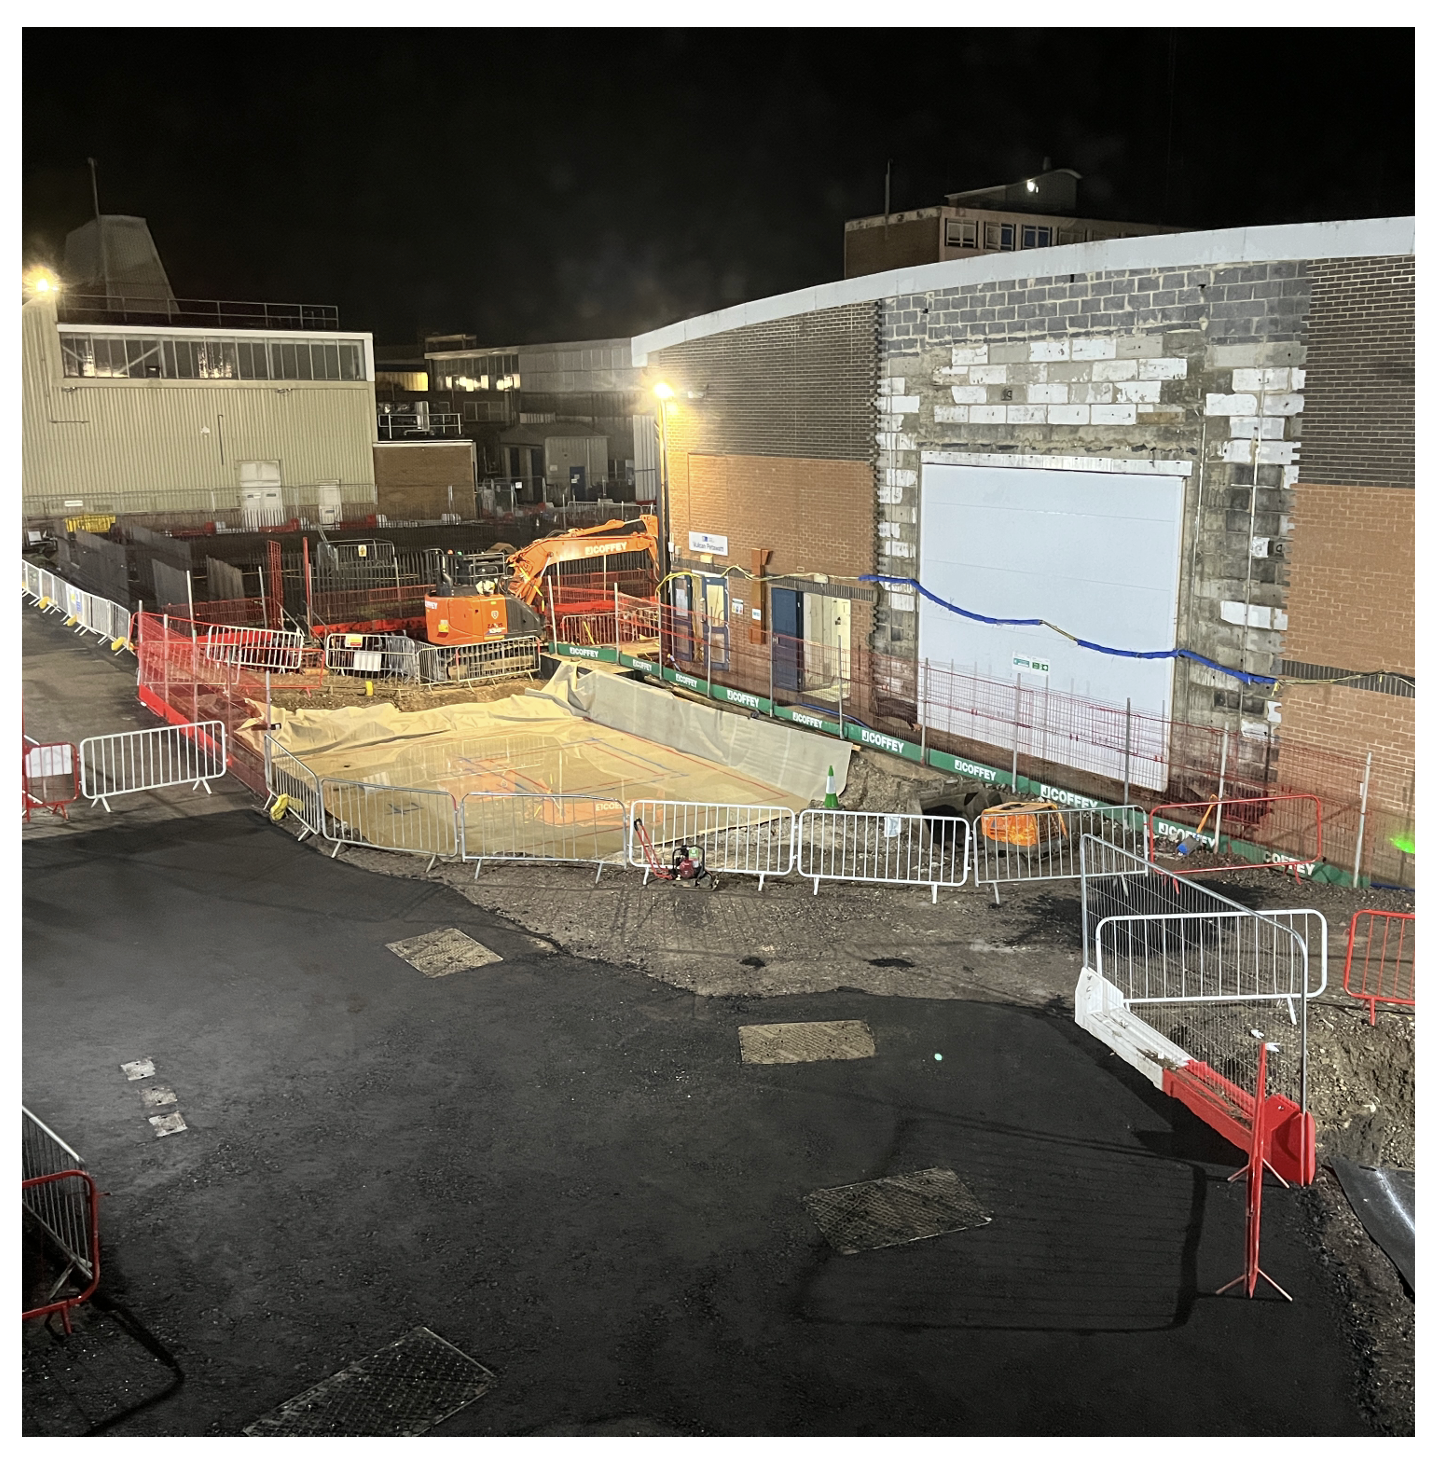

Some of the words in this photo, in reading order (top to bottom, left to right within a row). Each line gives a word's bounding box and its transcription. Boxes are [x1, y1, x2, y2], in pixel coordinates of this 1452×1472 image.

[593, 541, 627, 554] COFFEY
[574, 647, 599, 658] COFFEY
[734, 691, 760, 708] COFFEY
[799, 713, 823, 729] COFFEY
[869, 732, 905, 754] COFFEY
[962, 761, 997, 782] COFFEY
